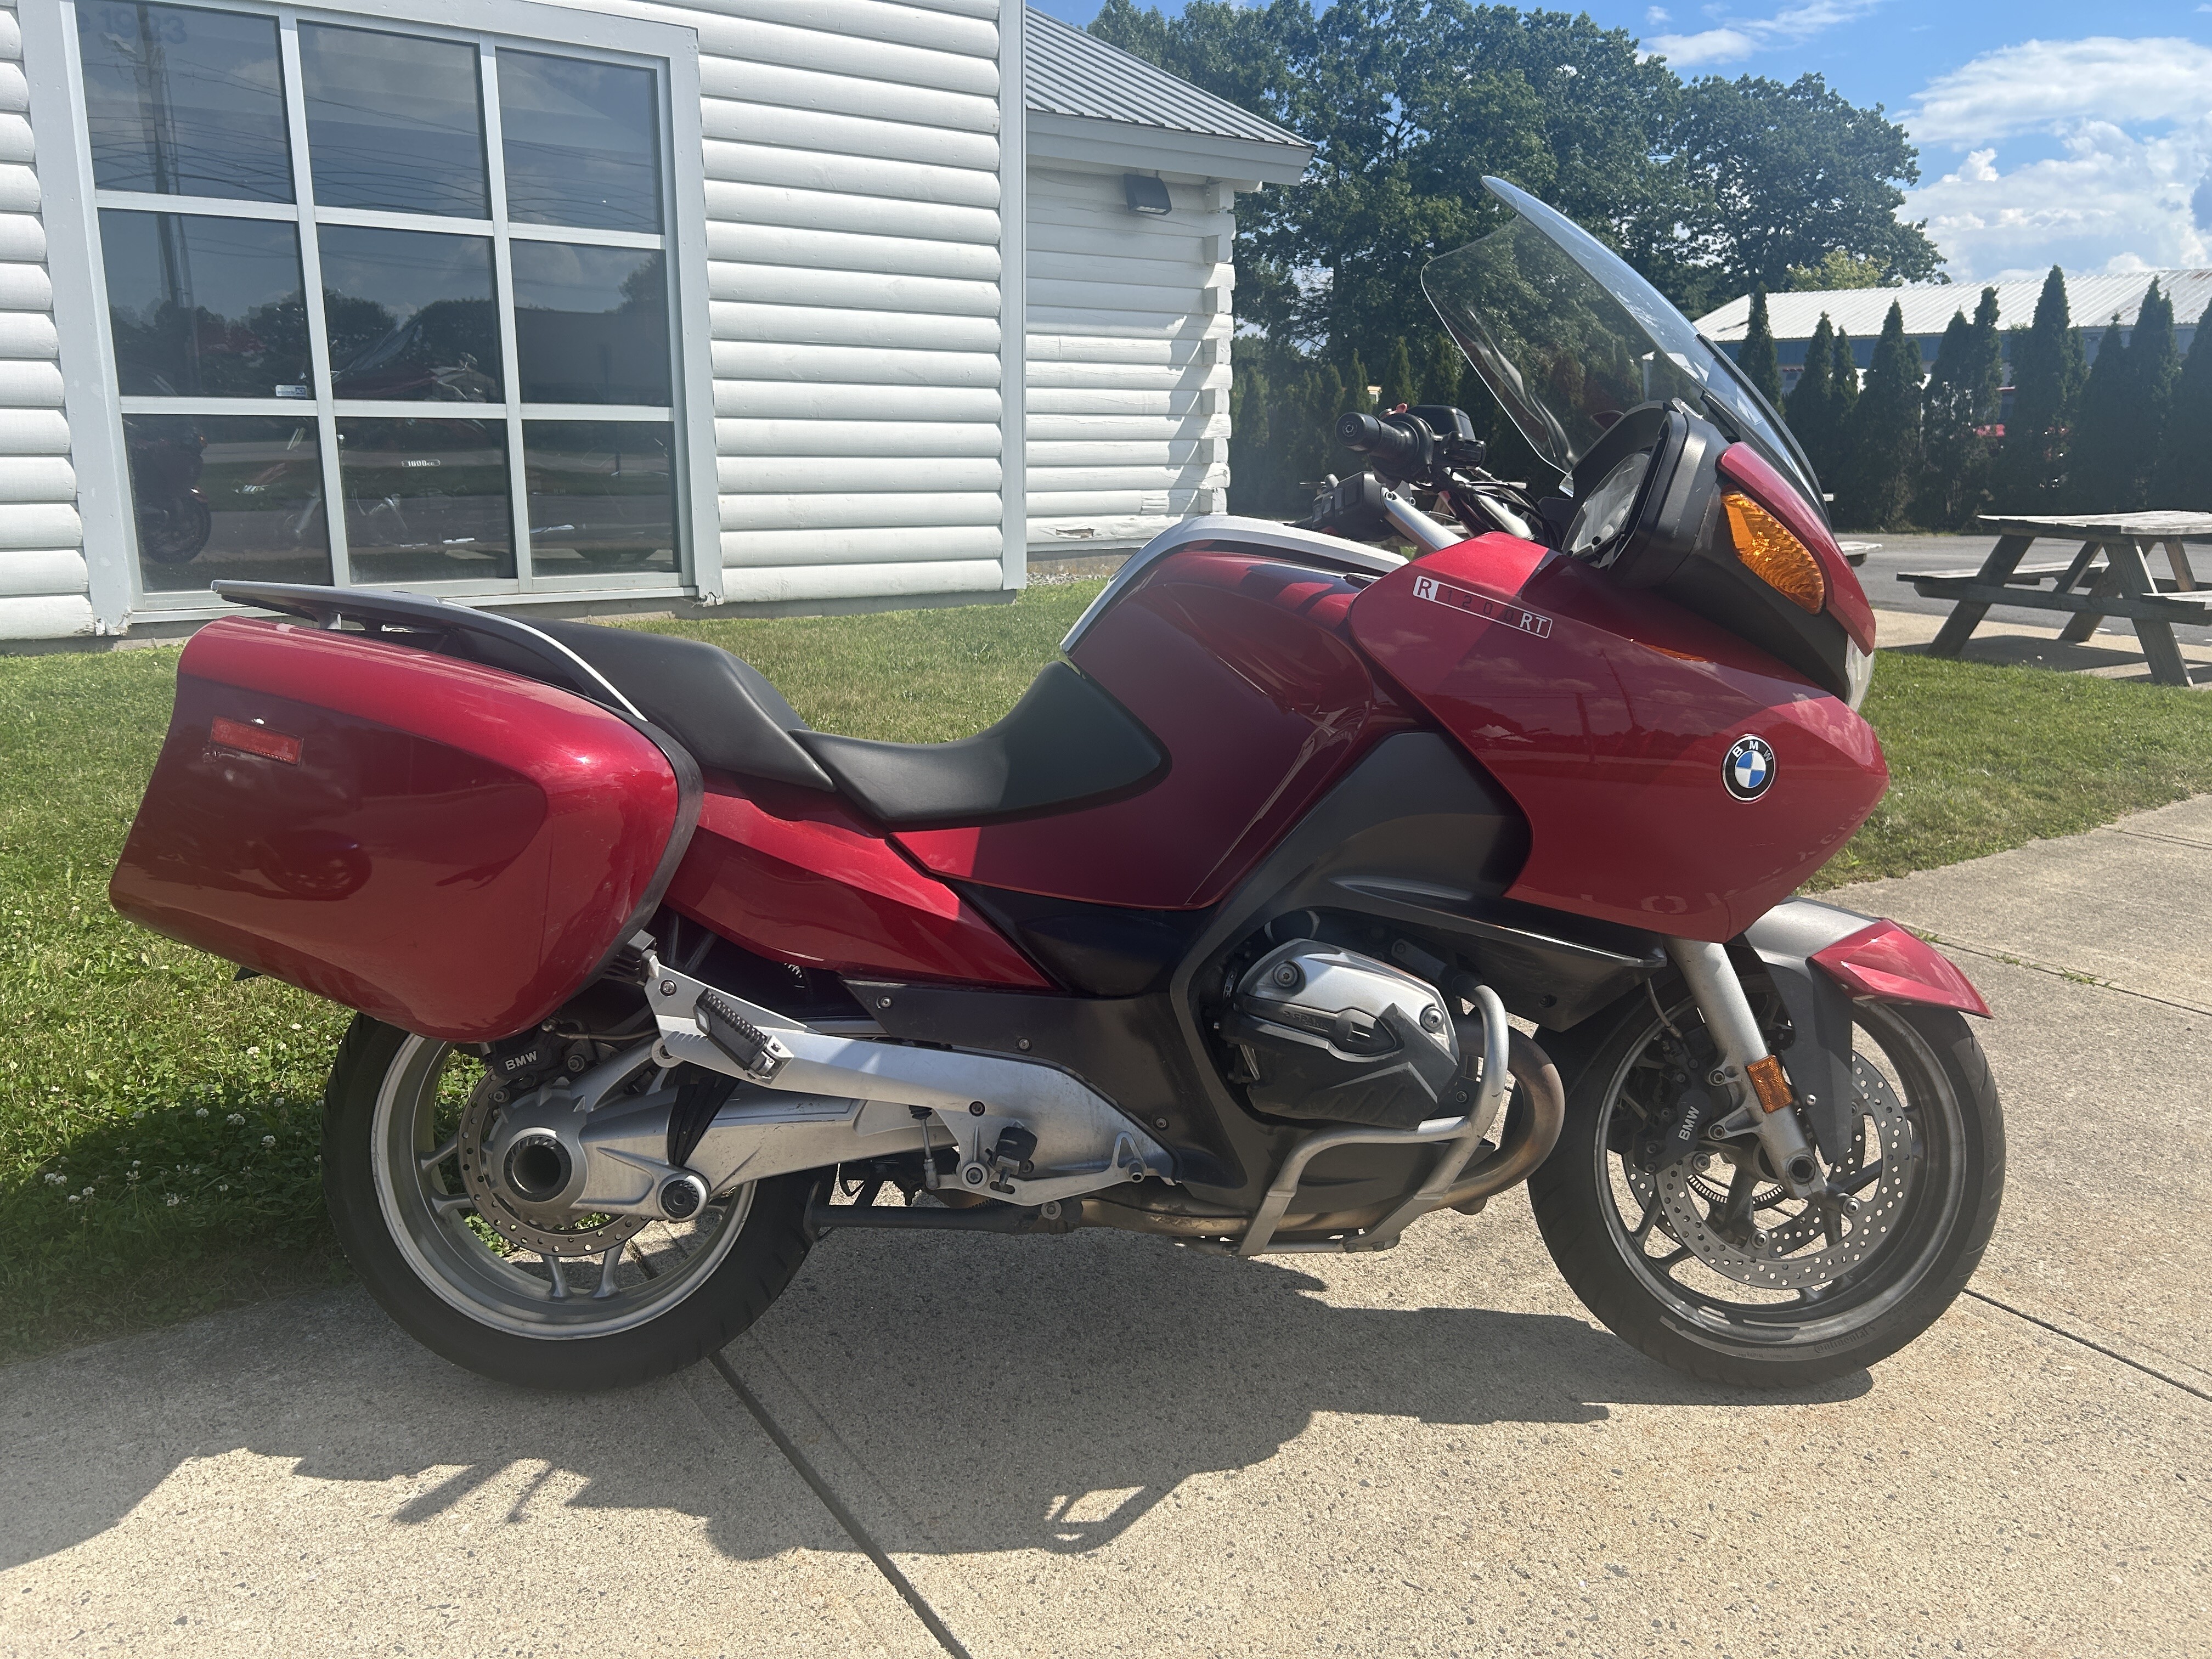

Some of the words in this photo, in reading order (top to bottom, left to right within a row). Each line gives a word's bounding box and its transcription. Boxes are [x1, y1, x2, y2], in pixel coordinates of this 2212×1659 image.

[1417, 578, 1432, 599] R
[1732, 740, 1773, 763] BMW
[505, 1051, 537, 1070] BMW
[1678, 1105, 1700, 1141] BMW
